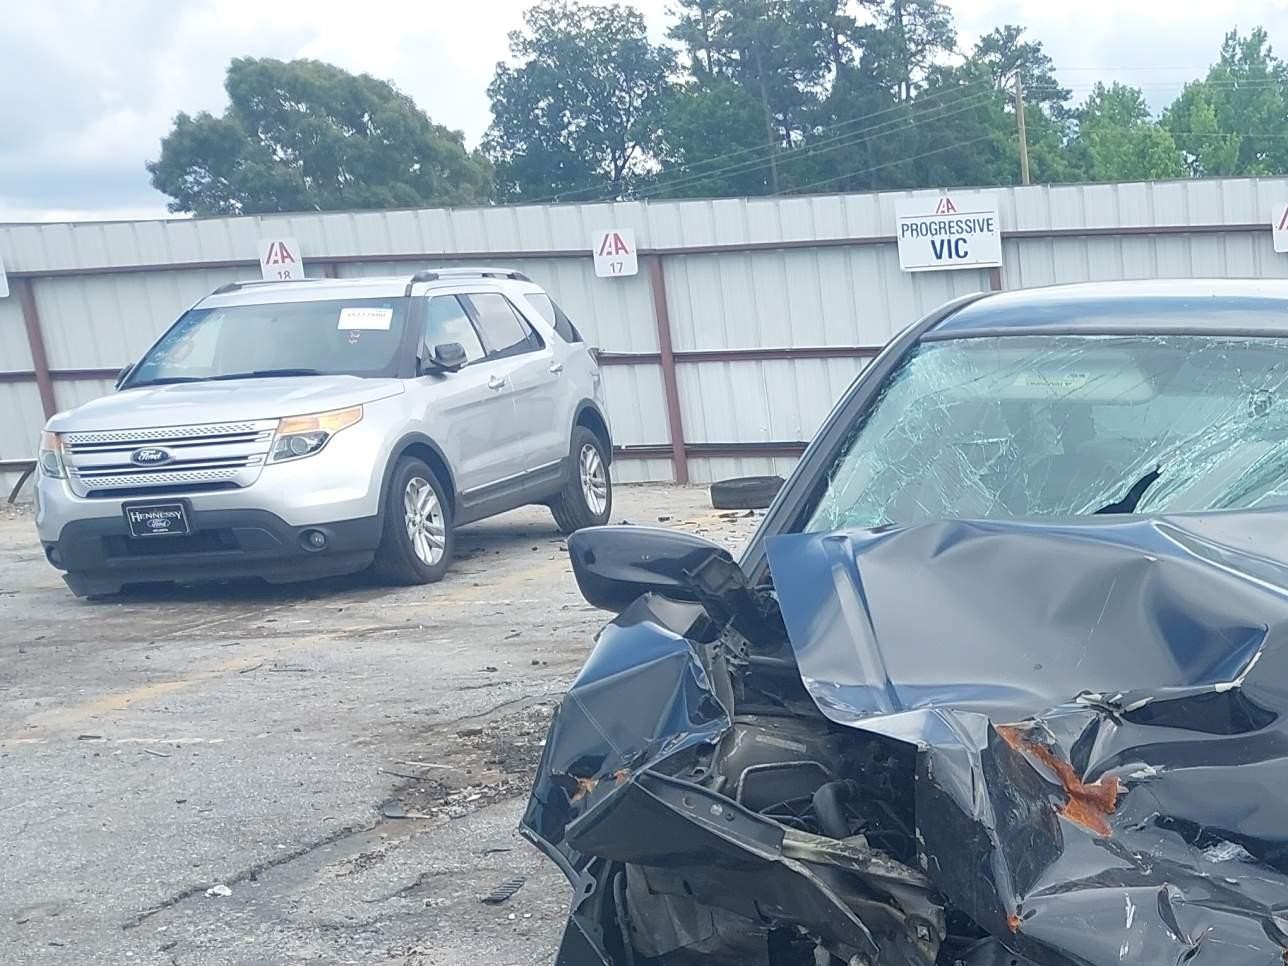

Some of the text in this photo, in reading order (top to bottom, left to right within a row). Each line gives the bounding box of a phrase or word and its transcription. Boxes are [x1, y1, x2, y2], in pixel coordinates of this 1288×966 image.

[901, 217, 995, 239] PROGRESSIVE
[930, 237, 969, 260] VIC
[609, 261, 624, 273] 17
[137, 448, 166, 461] Ford
